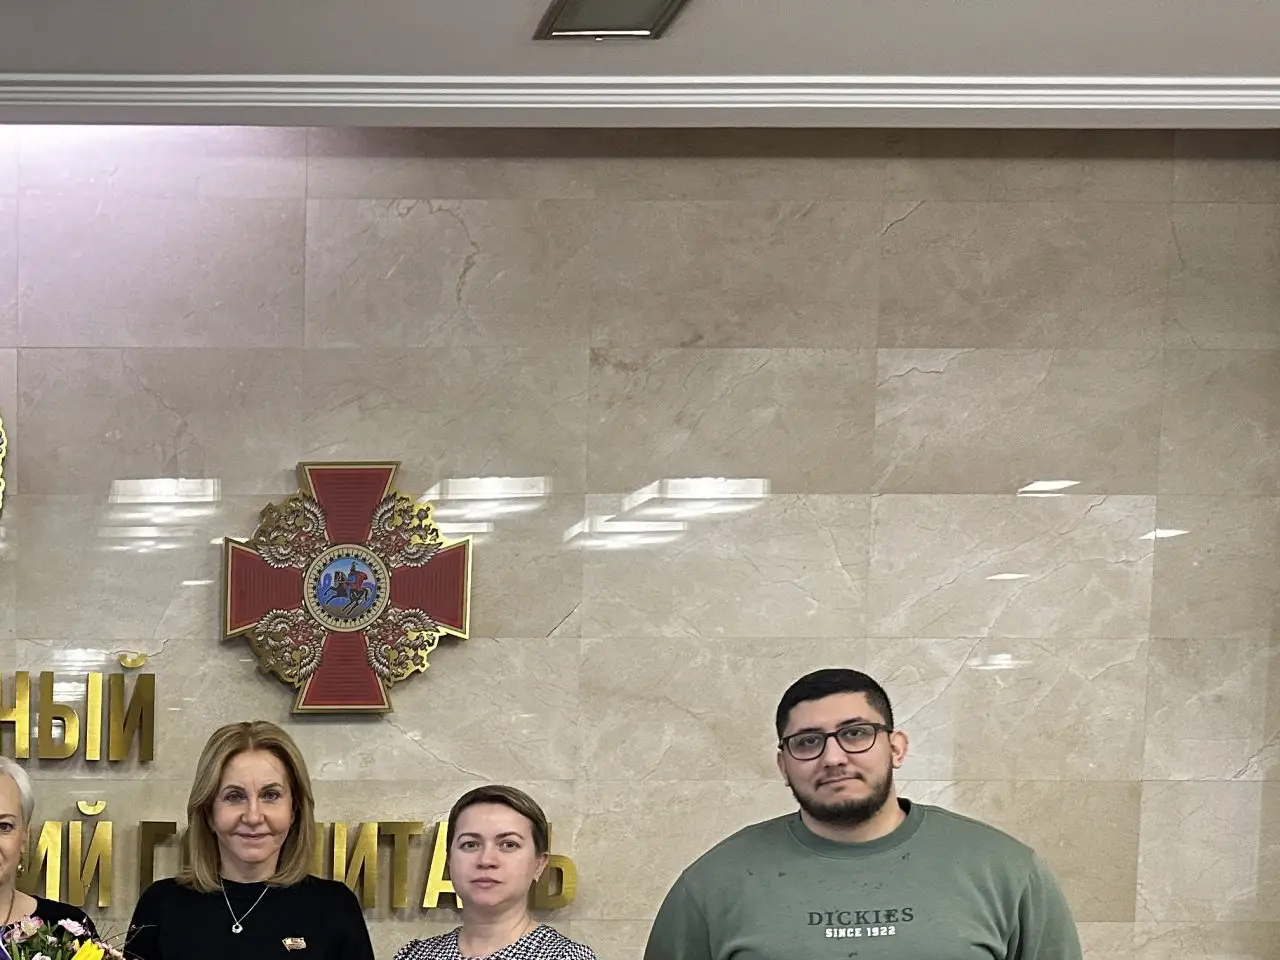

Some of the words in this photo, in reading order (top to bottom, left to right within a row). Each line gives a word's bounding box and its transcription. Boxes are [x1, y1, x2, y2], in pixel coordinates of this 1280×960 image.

[808, 907, 914, 926] DICKIES
[825, 927, 862, 938] SINCE
[867, 926, 896, 937] 1922
